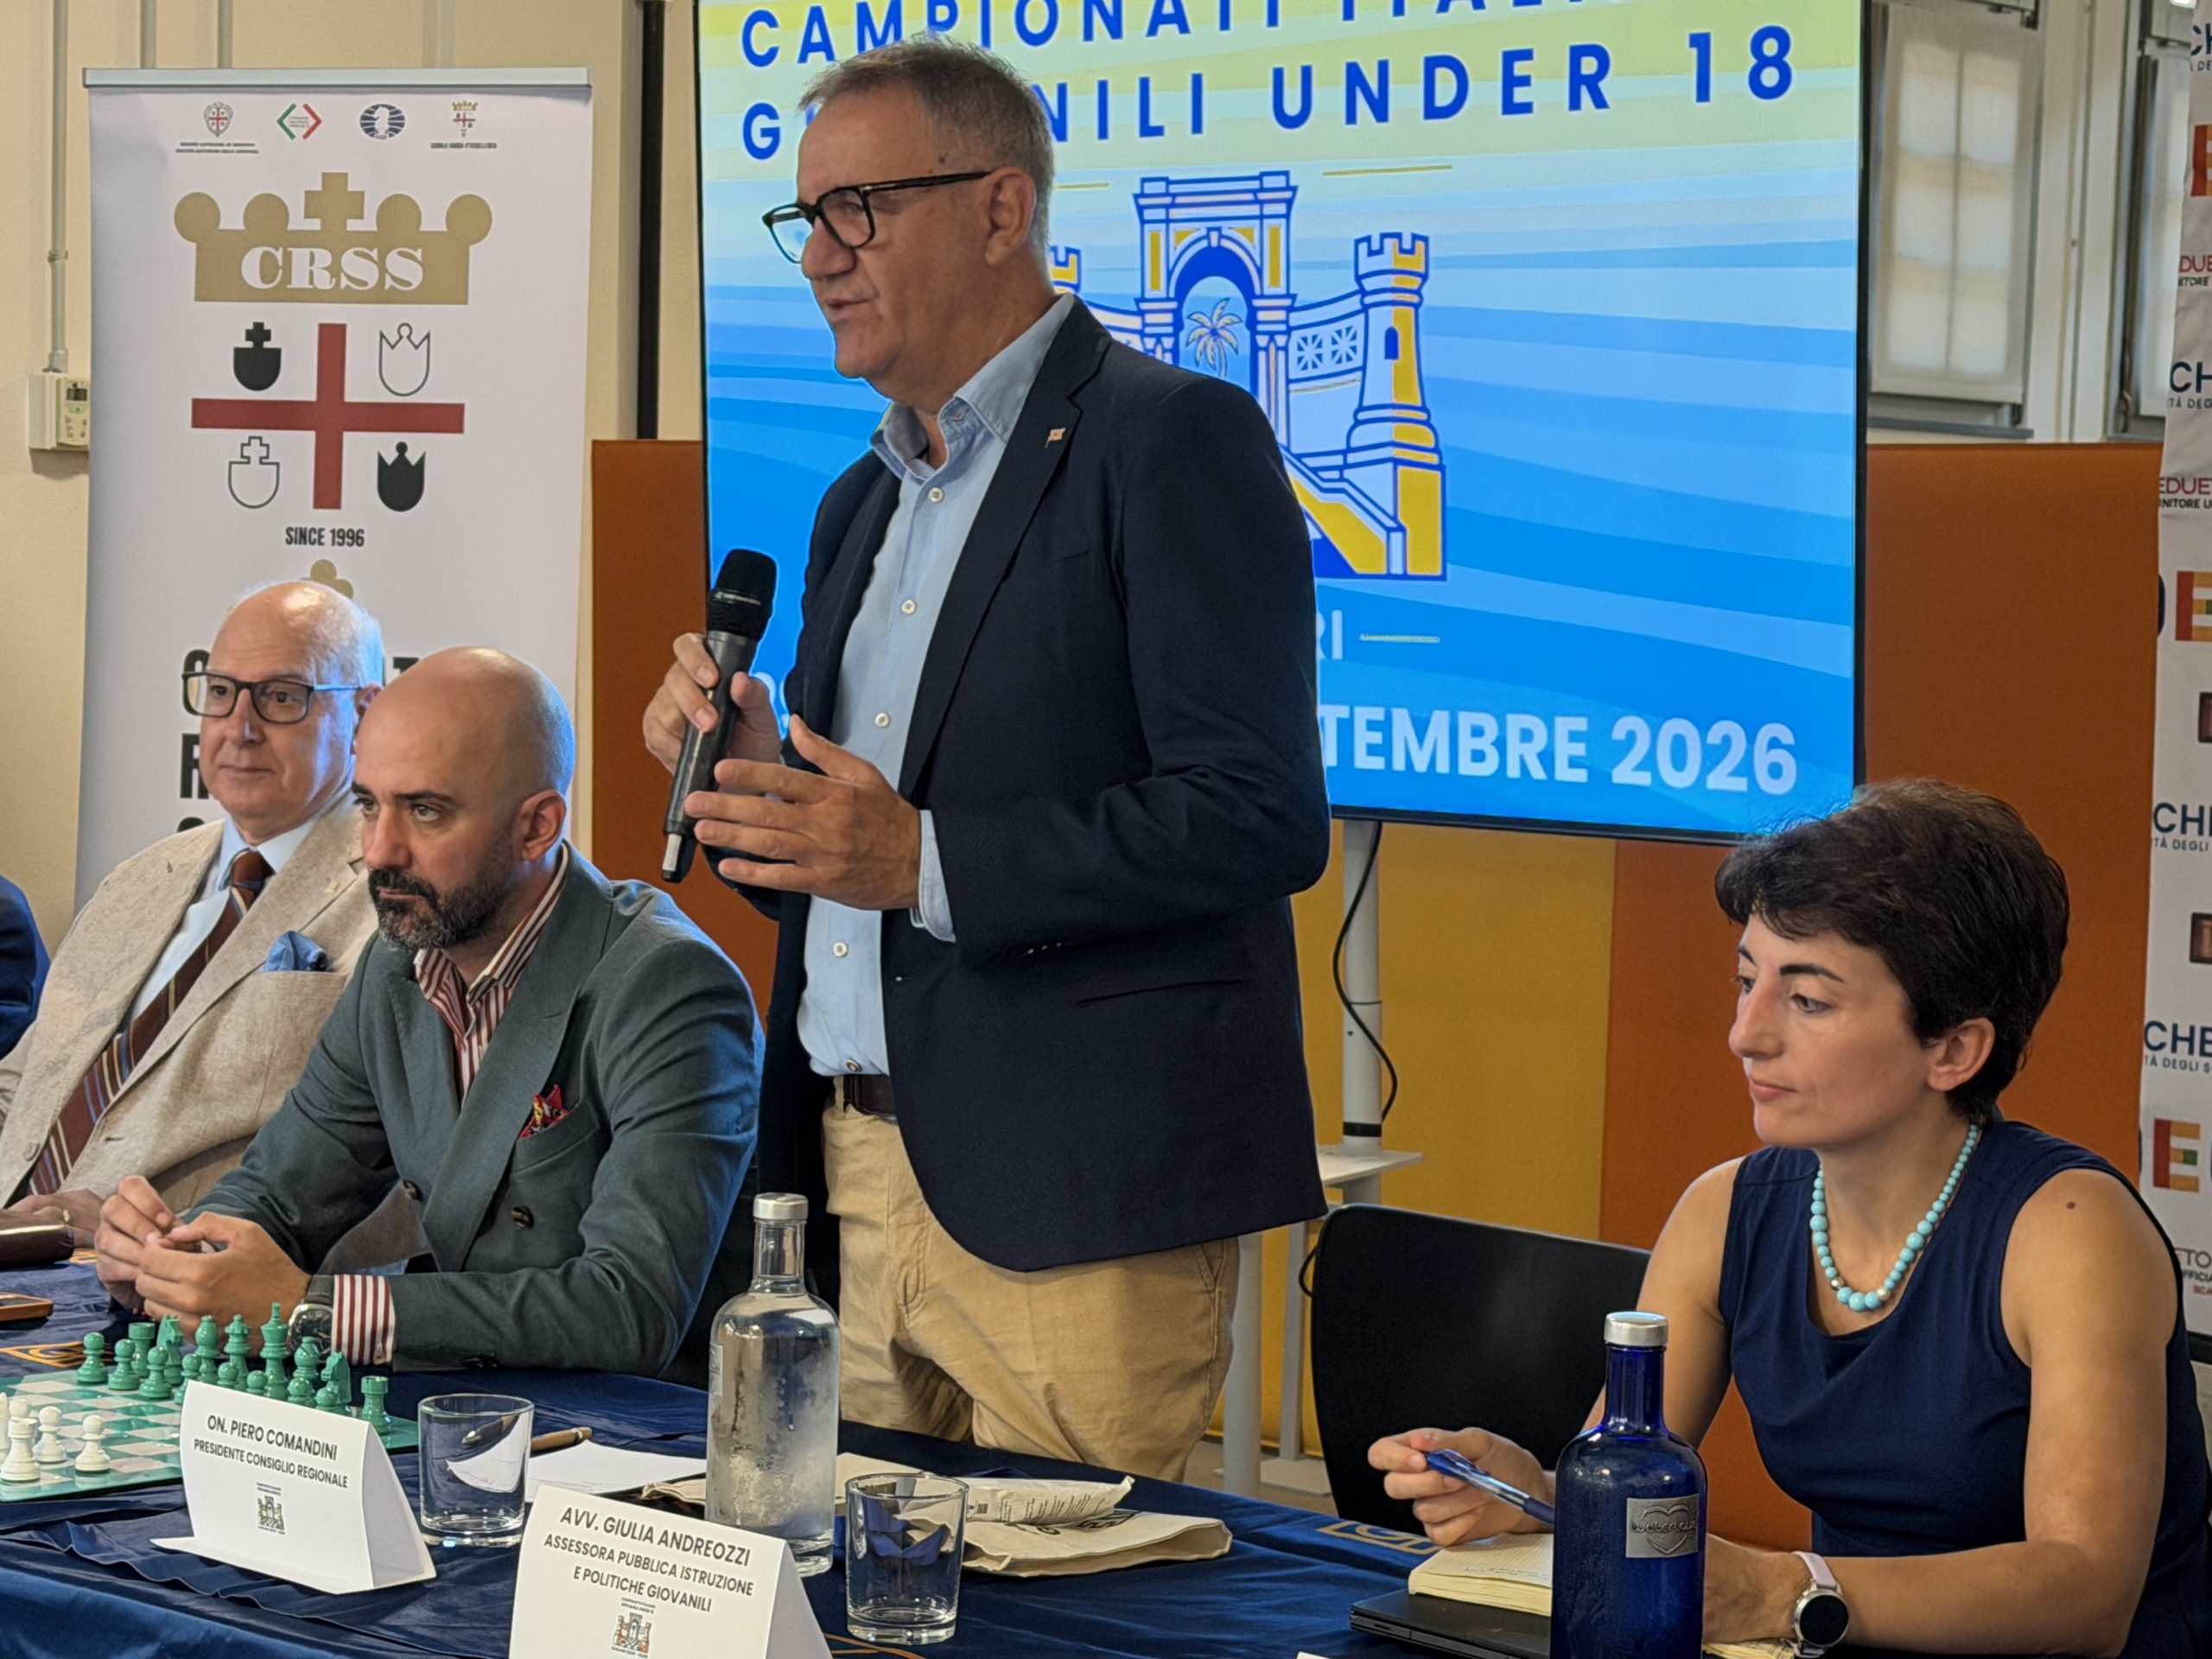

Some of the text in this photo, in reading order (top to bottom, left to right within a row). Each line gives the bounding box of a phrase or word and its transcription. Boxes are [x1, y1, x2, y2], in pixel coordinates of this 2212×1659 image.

[1272, 43, 1611, 129] UNDER
[1688, 25, 1792, 103] 18
[241, 246, 423, 291] CRSS
[285, 526, 365, 547] SINCE 1996
[1319, 704, 1796, 795] TEMBRE 2026
[207, 1414, 338, 1461] ON. PIERO COMANDINI
[194, 1439, 347, 1488] PRESIDENTE CONSIGLIO REGIONALE
[560, 1507, 751, 1567] AVV. GIULIA ANDREOZZI
[543, 1534, 753, 1596] ASSESSORA PUBBLICA ISTRUZIONE
[573, 1566, 582, 1580] E
[582, 1568, 646, 1596] POLITICHE
[647, 1584, 712, 1612] GIOVANILI
